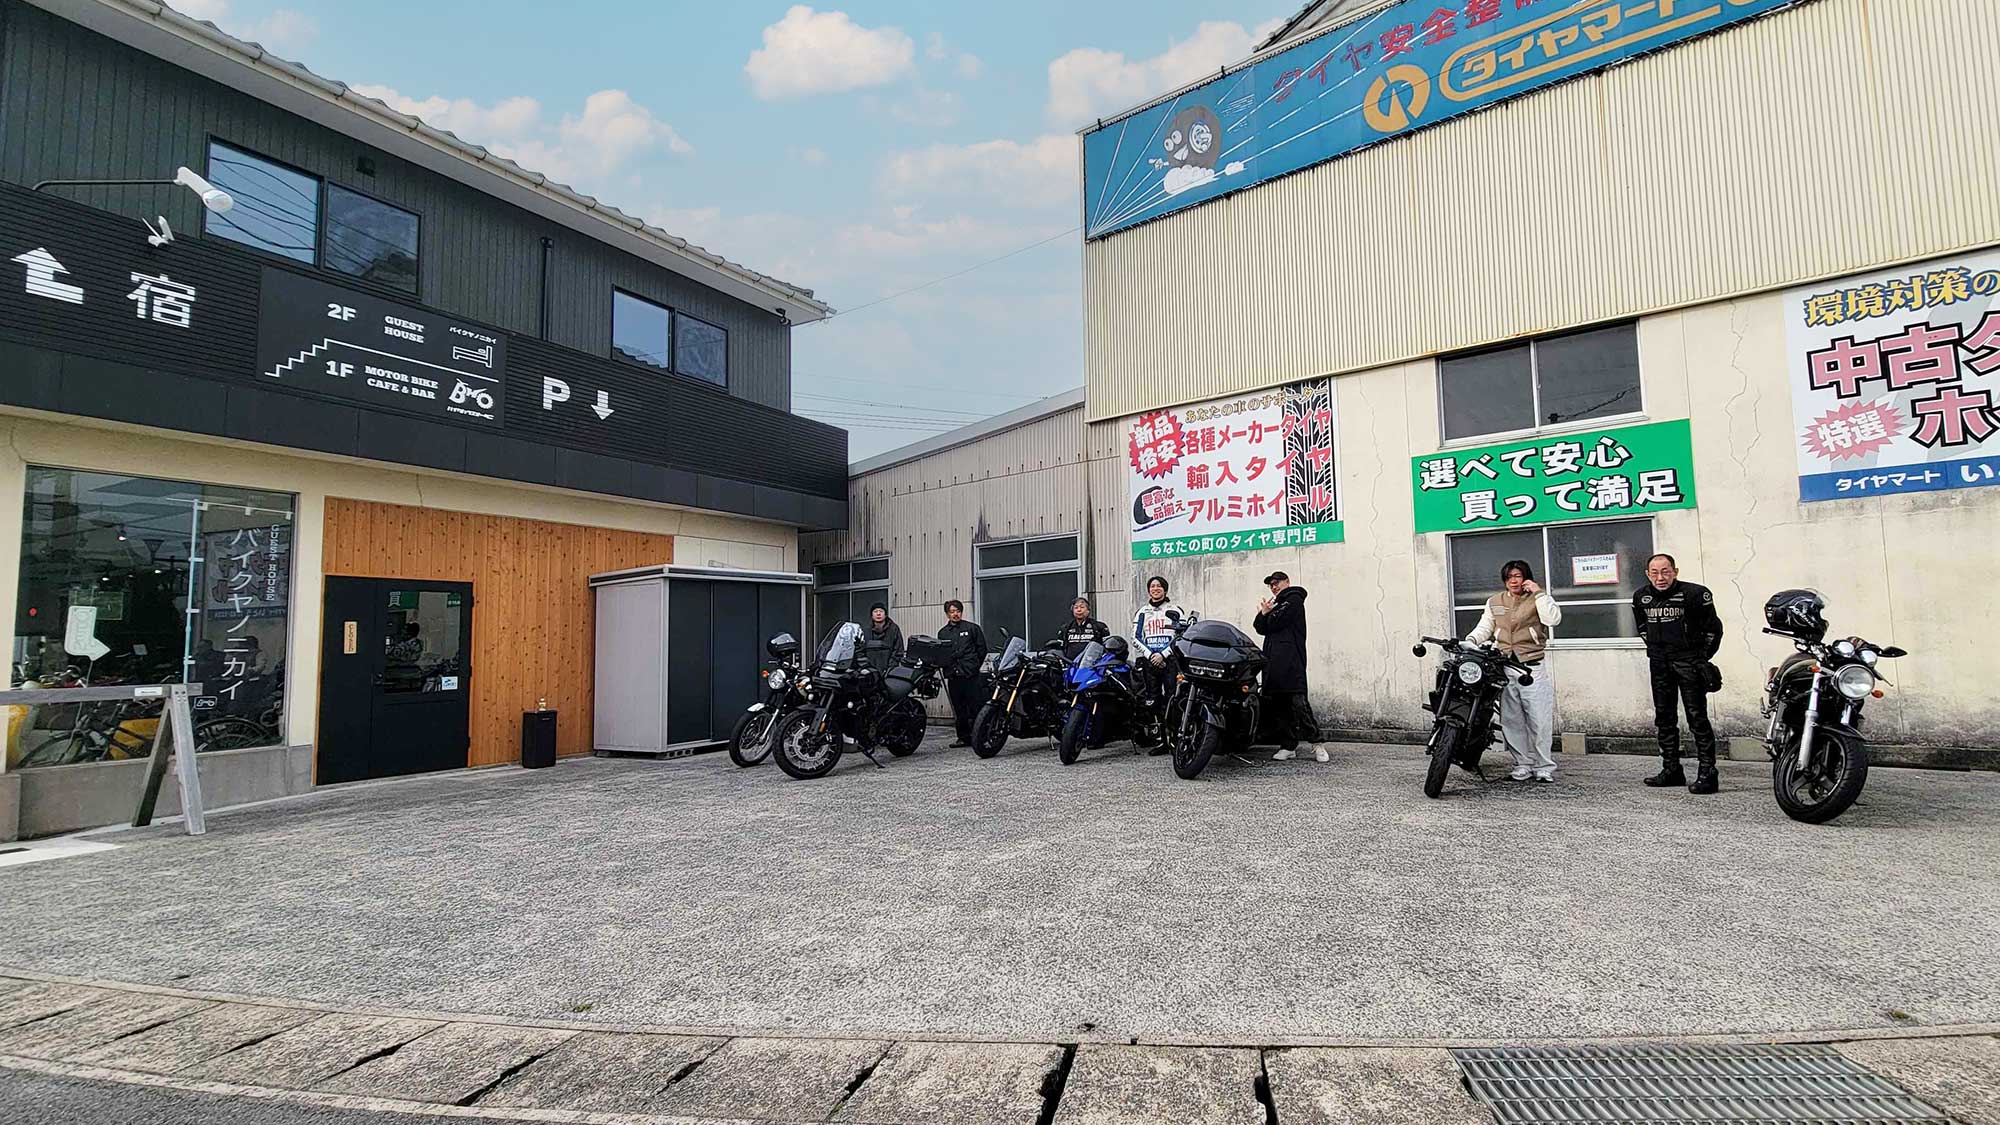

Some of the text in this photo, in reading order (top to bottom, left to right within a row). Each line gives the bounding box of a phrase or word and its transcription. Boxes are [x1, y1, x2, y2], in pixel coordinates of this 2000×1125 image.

[1272, 0, 1543, 103] タイヤ安全整
[126, 273, 196, 328] 宿
[327, 303, 357, 321] 2F
[1804, 266, 2000, 327] 環境対策の
[384, 315, 425, 332] GUEST
[384, 326, 425, 343] HOUSE
[325, 360, 354, 378] 1F
[364, 365, 439, 389] MOTOR BIKE
[366, 377, 436, 400] CAFE & BAR
[543, 376, 570, 411] P
[1184, 387, 1329, 424] あなたの車のサポーター
[1133, 415, 1174, 448] 新品
[1184, 408, 1332, 456] 各種メーカータイヤ
[1817, 409, 1888, 452] 特選
[1909, 384, 2000, 449] ホ
[1138, 439, 1178, 471] 格安
[1186, 446, 1332, 490] 輸入タイヤ
[1419, 435, 1633, 491] 選べて安心
[1459, 468, 1686, 523] 買って満足
[1835, 469, 1941, 492] タイヤマート
[1187, 484, 1332, 524] アルミホイール
[1150, 527, 1317, 556] あなたの町のタイヤ専門店
[266, 524, 280, 601] GUEST HOUSE
[219, 528, 261, 700] バイクヤノニカイ
[1147, 619, 1165, 635] FIAT
